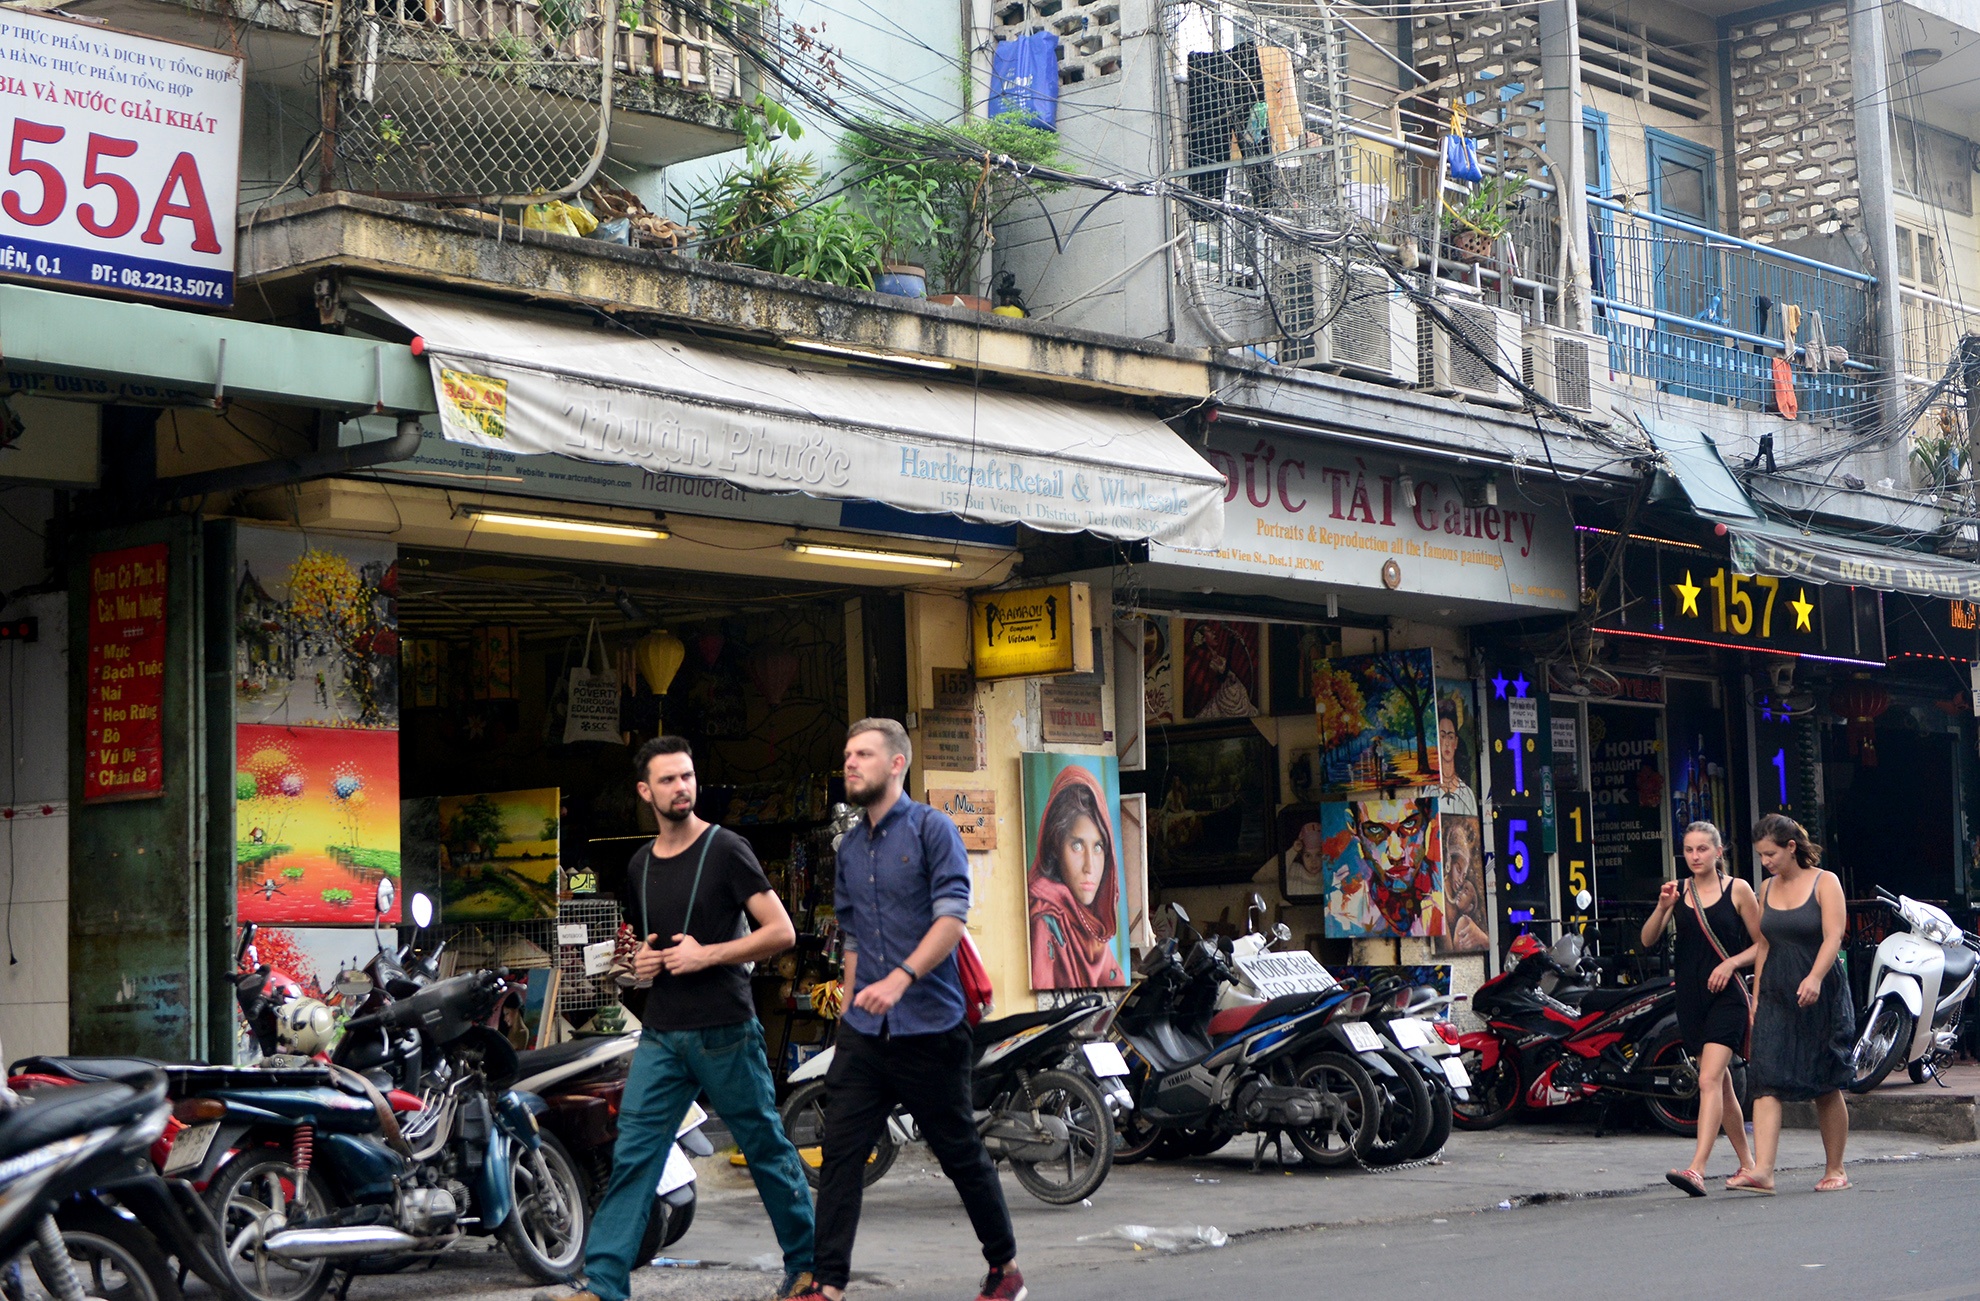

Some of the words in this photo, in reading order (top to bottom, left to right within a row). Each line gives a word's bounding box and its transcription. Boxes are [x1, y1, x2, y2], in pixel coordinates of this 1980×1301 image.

[13, 26, 48, 44] THỰC
[52, 34, 90, 53] PHẨM
[93, 43, 110, 58] VÀ
[114, 48, 146, 65] DỊCH
[149, 56, 166, 71] VỤ
[169, 57, 203, 78] TỔNG
[206, 68, 230, 83] HỢP
[10, 48, 47, 68] HÀNG
[51, 58, 87, 75] THỰC
[90, 65, 127, 84] PHẨM
[130, 72, 164, 92] TỔNG
[168, 82, 194, 97] HỢP
[33, 81, 58, 103] VÀ
[64, 88, 117, 114] NƯỚC
[120, 99, 162, 124] GIẢI
[165, 112, 217, 134] KHÁT
[1, 117, 222, 254] 55A
[36, 255, 61, 275] Q.1
[92, 264, 117, 282] ĐT:
[121, 268, 223, 299] 08.2213.5074
[563, 397, 712, 474] Thuận
[718, 422, 850, 488] Phước
[460, 447, 478, 458] TEL:
[411, 455, 502, 472] nphuocshop@gmail.com
[515, 466, 547, 478] Website:
[548, 471, 632, 488] www.artcraftsaigon.com
[1071, 472, 1091, 502] &
[1098, 476, 1188, 516] Wholesale
[1322, 456, 1396, 527] TÀI
[940, 491, 959, 507] 155
[965, 494, 984, 510] Bui
[990, 496, 1021, 517] Vien,
[1036, 503, 1081, 524] District,
[1085, 510, 1107, 526] Tel:
[1257, 518, 1304, 541] Portraits
[1308, 524, 1317, 543] &
[1319, 526, 1388, 552] Reproduction
[1391, 538, 1403, 554] all
[1406, 540, 1420, 556] the
[1424, 541, 1458, 561] famous
[1461, 549, 1504, 570] paintings
[1232, 548, 1251, 561] Vien
[1765, 547, 1816, 575] 157
[1839, 560, 1896, 586] MỘT
[1905, 568, 1960, 594] NĂM
[1709, 567, 1779, 638] 157
[1009, 624, 1033, 634] Company
[1008, 634, 1037, 644] Vietnam
[101, 663, 135, 683] Bạch
[101, 685, 122, 701] Nai
[573, 688, 618, 698] POVERTY
[940, 673, 968, 694] 155
[103, 706, 127, 722] Heo
[571, 704, 618, 714] EDUCATION
[1075, 711, 1097, 727] NAM
[102, 727, 121, 744] Bò
[100, 748, 119, 765] Vú
[1605, 740, 1656, 758] HOUR
[98, 769, 131, 786] Chân
[132, 766, 147, 783] Gà
[1605, 774, 1626, 786] PM
[956, 824, 976, 834] OUSE
[1626, 832, 1640, 841] DOG
[1605, 857, 1623, 866] BEER
[1242, 957, 1299, 980] MOTOR
[1287, 955, 1327, 976] BIKE
[1167, 1070, 1193, 1087] YAMAHA
